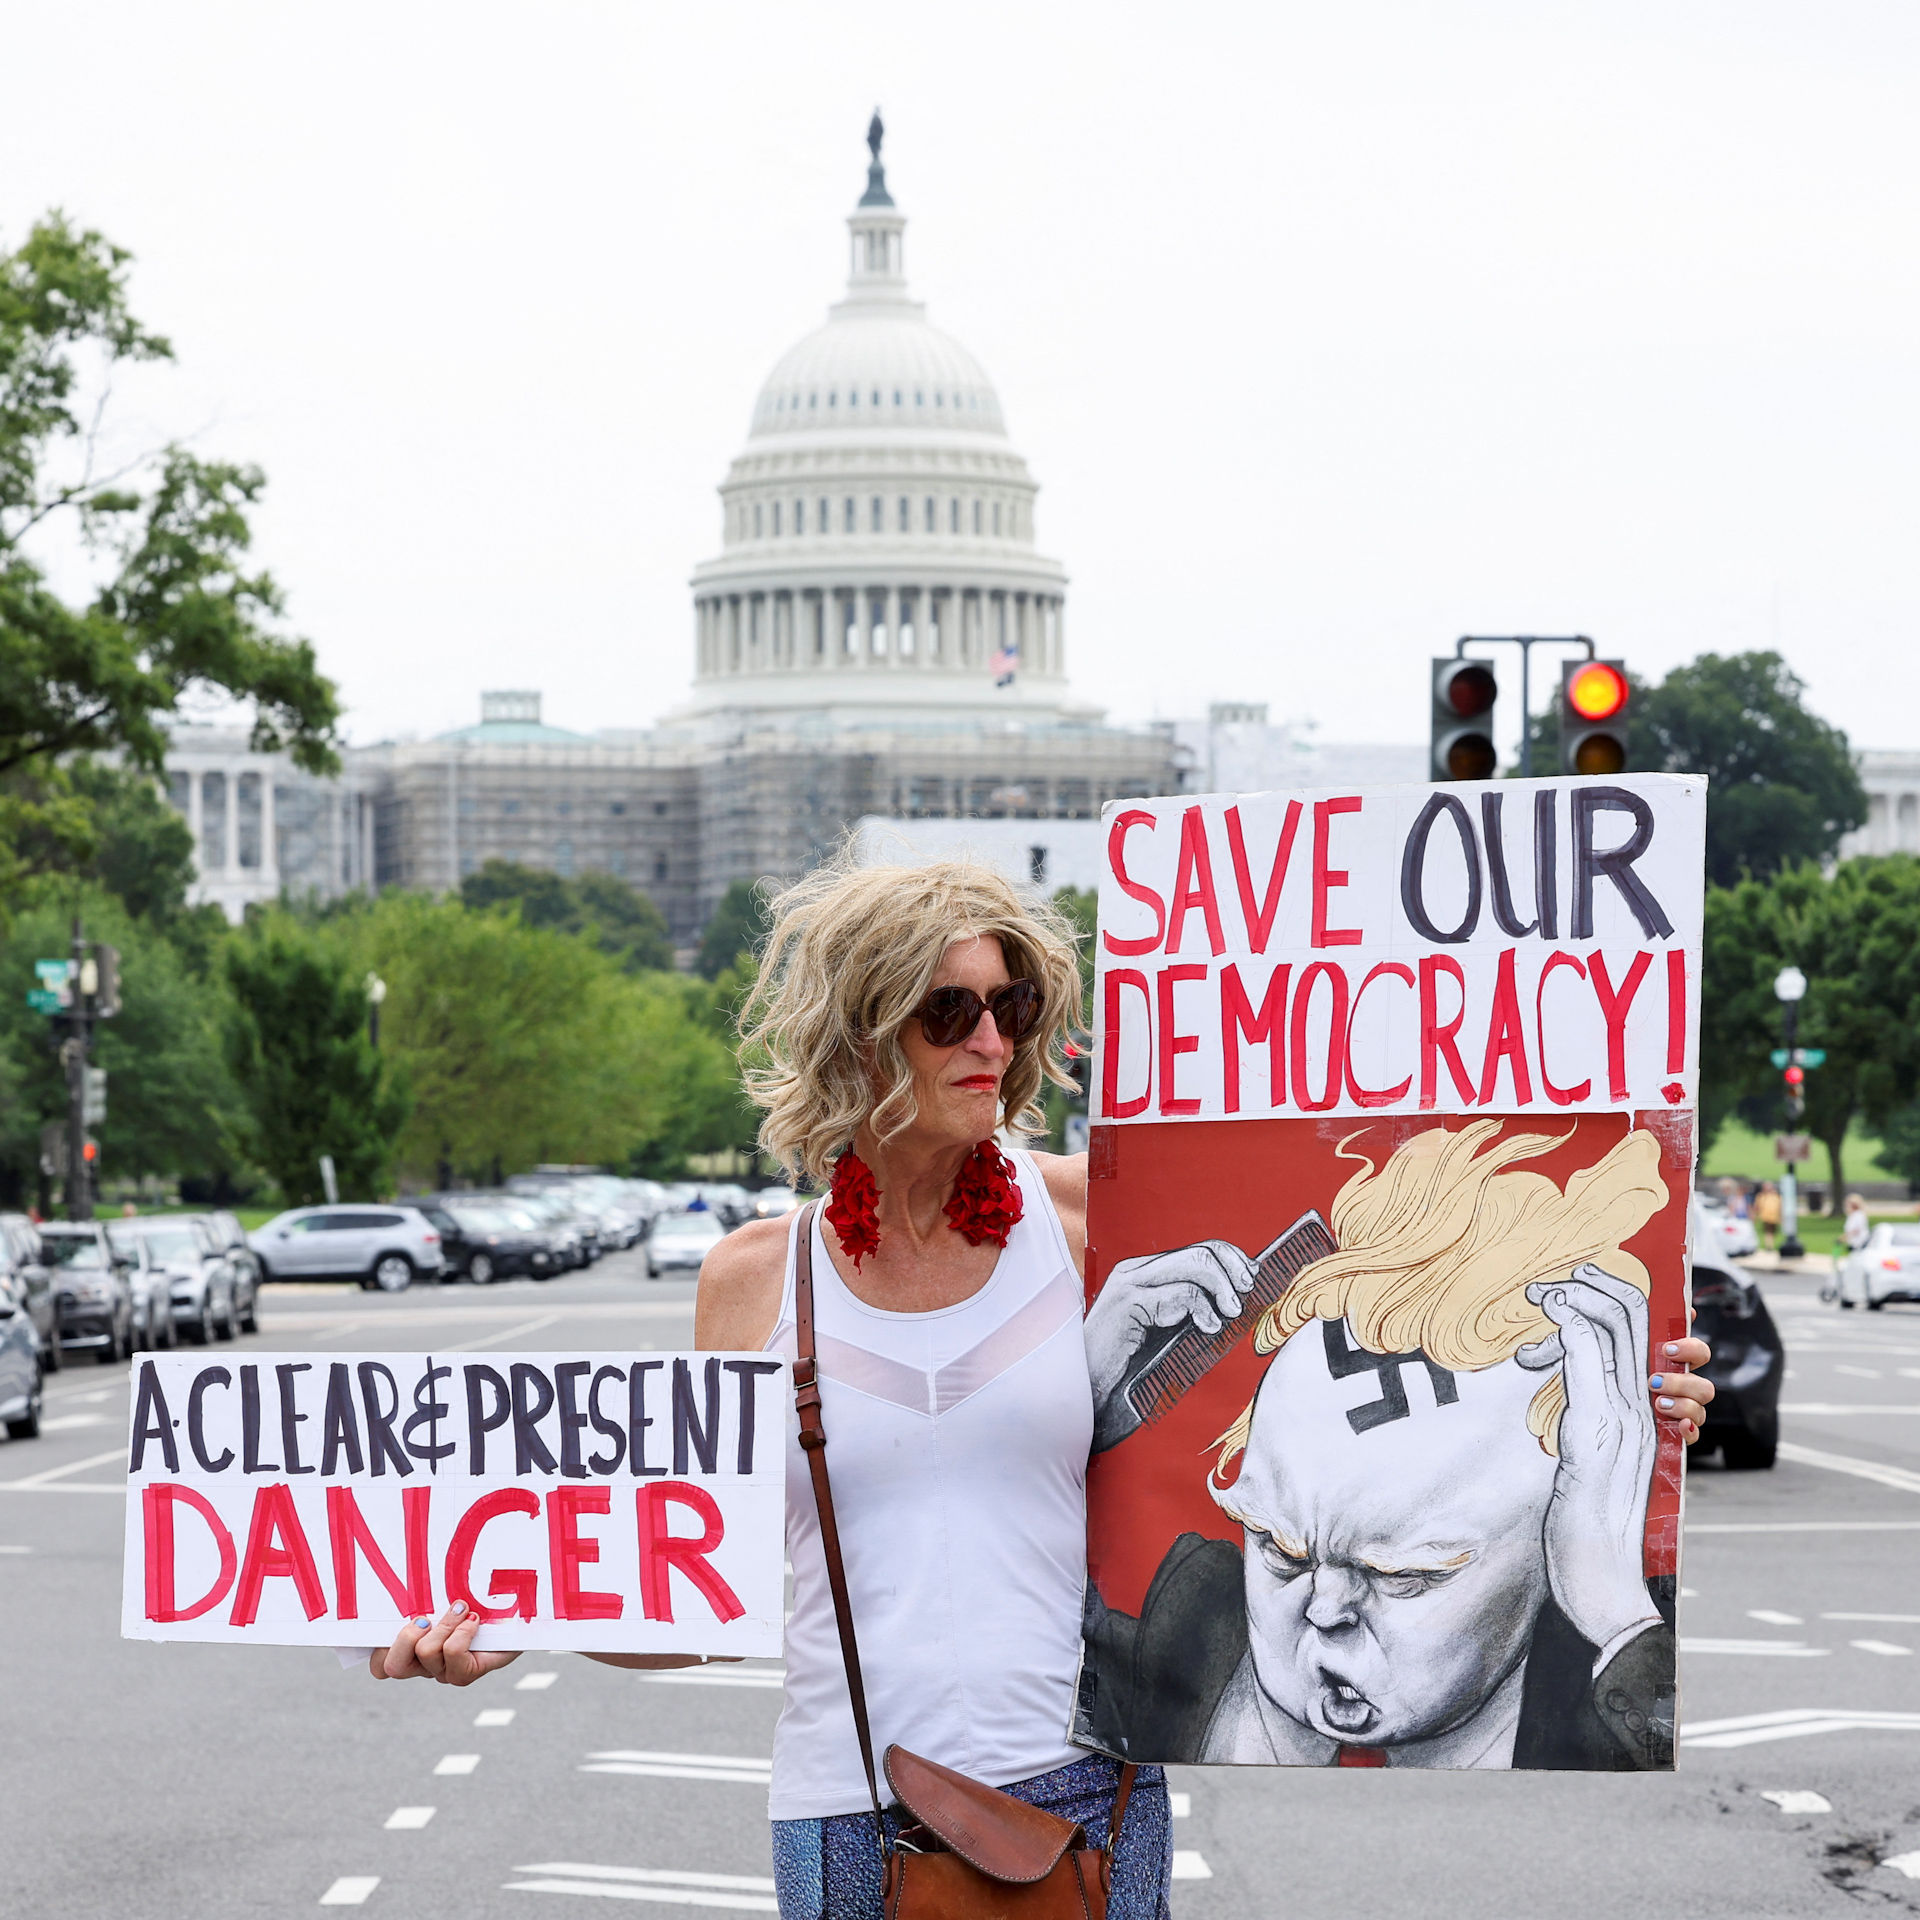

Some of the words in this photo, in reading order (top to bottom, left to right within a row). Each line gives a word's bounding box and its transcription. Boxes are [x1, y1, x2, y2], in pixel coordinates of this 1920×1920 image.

[1102, 796, 1363, 957] SAVE
[1400, 785, 1676, 945] OUR
[1101, 947, 1687, 1120] DEMOCRACY!
[187, 1361, 415, 1478] CLEAR
[401, 1355, 456, 1477] &
[463, 1356, 784, 1479] PRESENT
[142, 1480, 747, 1628] DANGER
